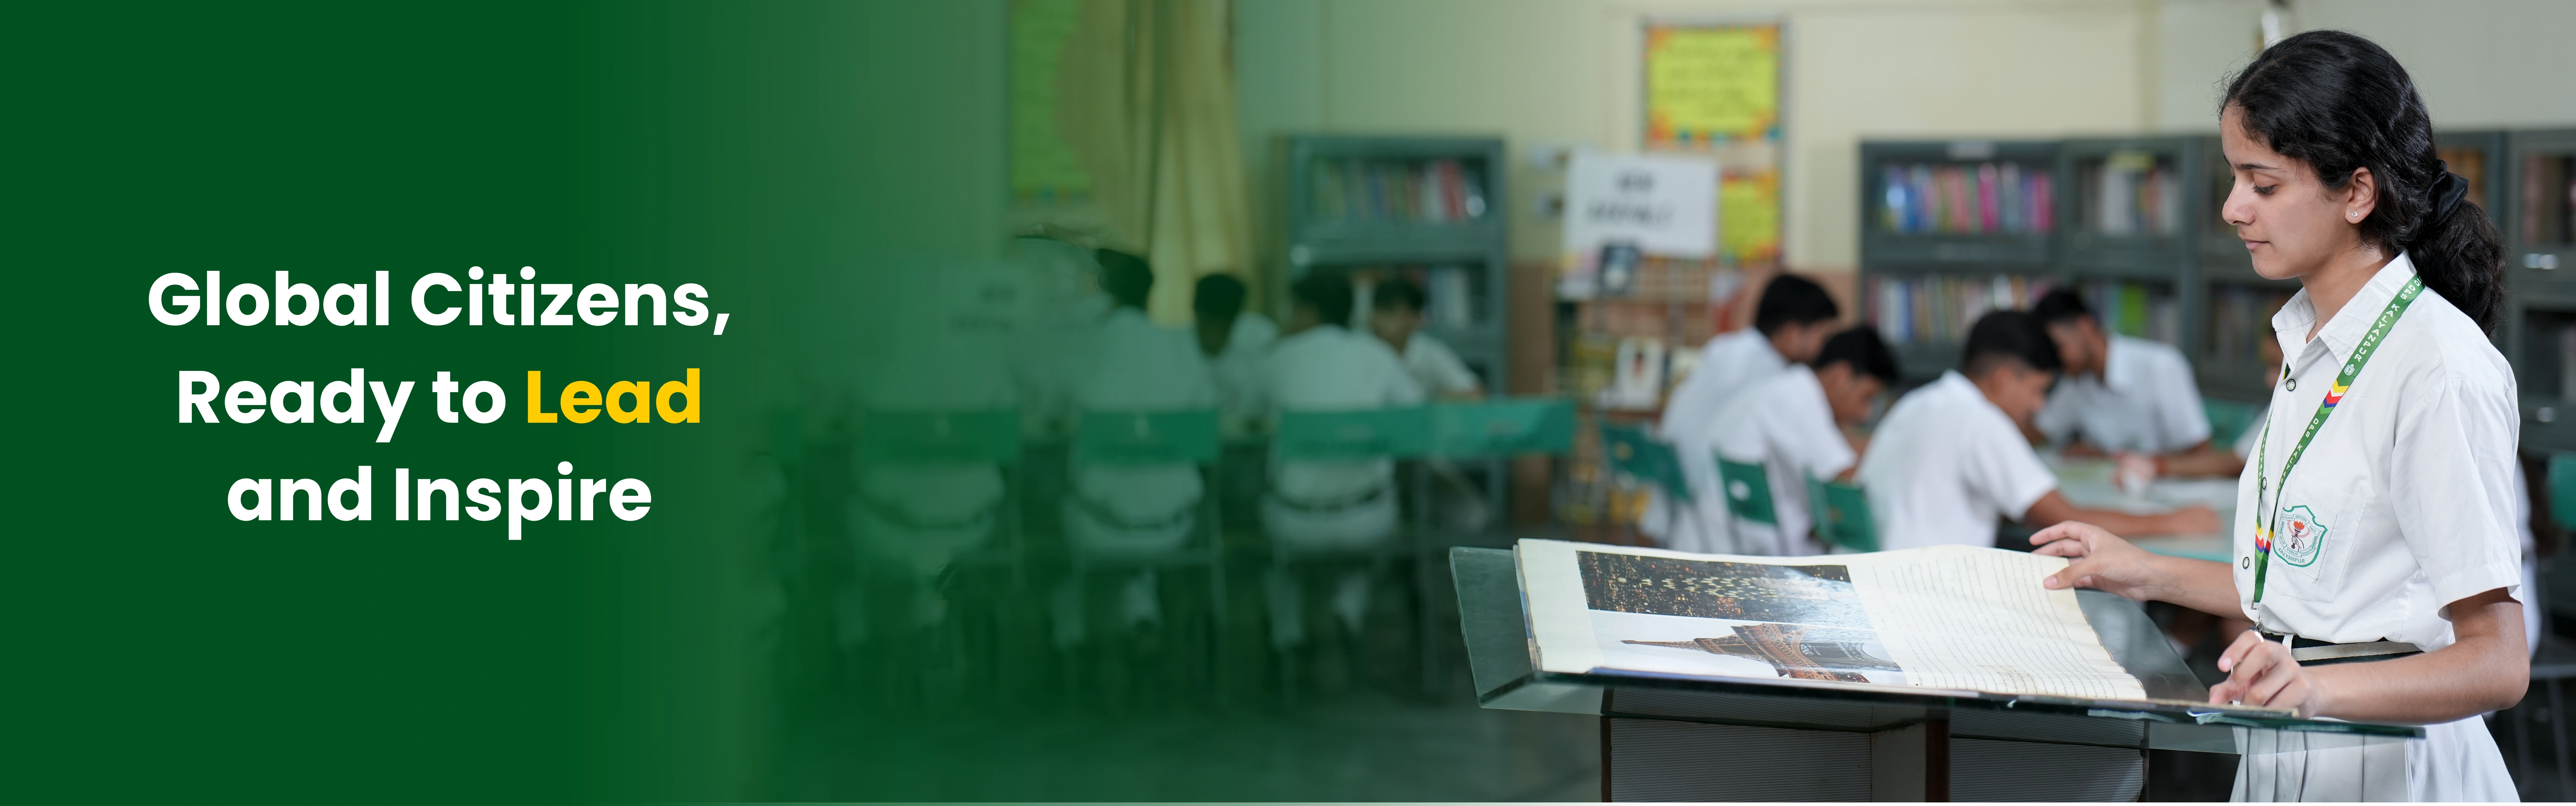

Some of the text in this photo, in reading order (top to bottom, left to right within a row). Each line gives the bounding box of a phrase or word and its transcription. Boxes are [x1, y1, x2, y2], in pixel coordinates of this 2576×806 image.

[2354, 284, 2416, 362] DPS KALYANPUR
[2277, 418, 2319, 494] DPS KALYANP
[2278, 548, 2305, 563] KALYANPUR
